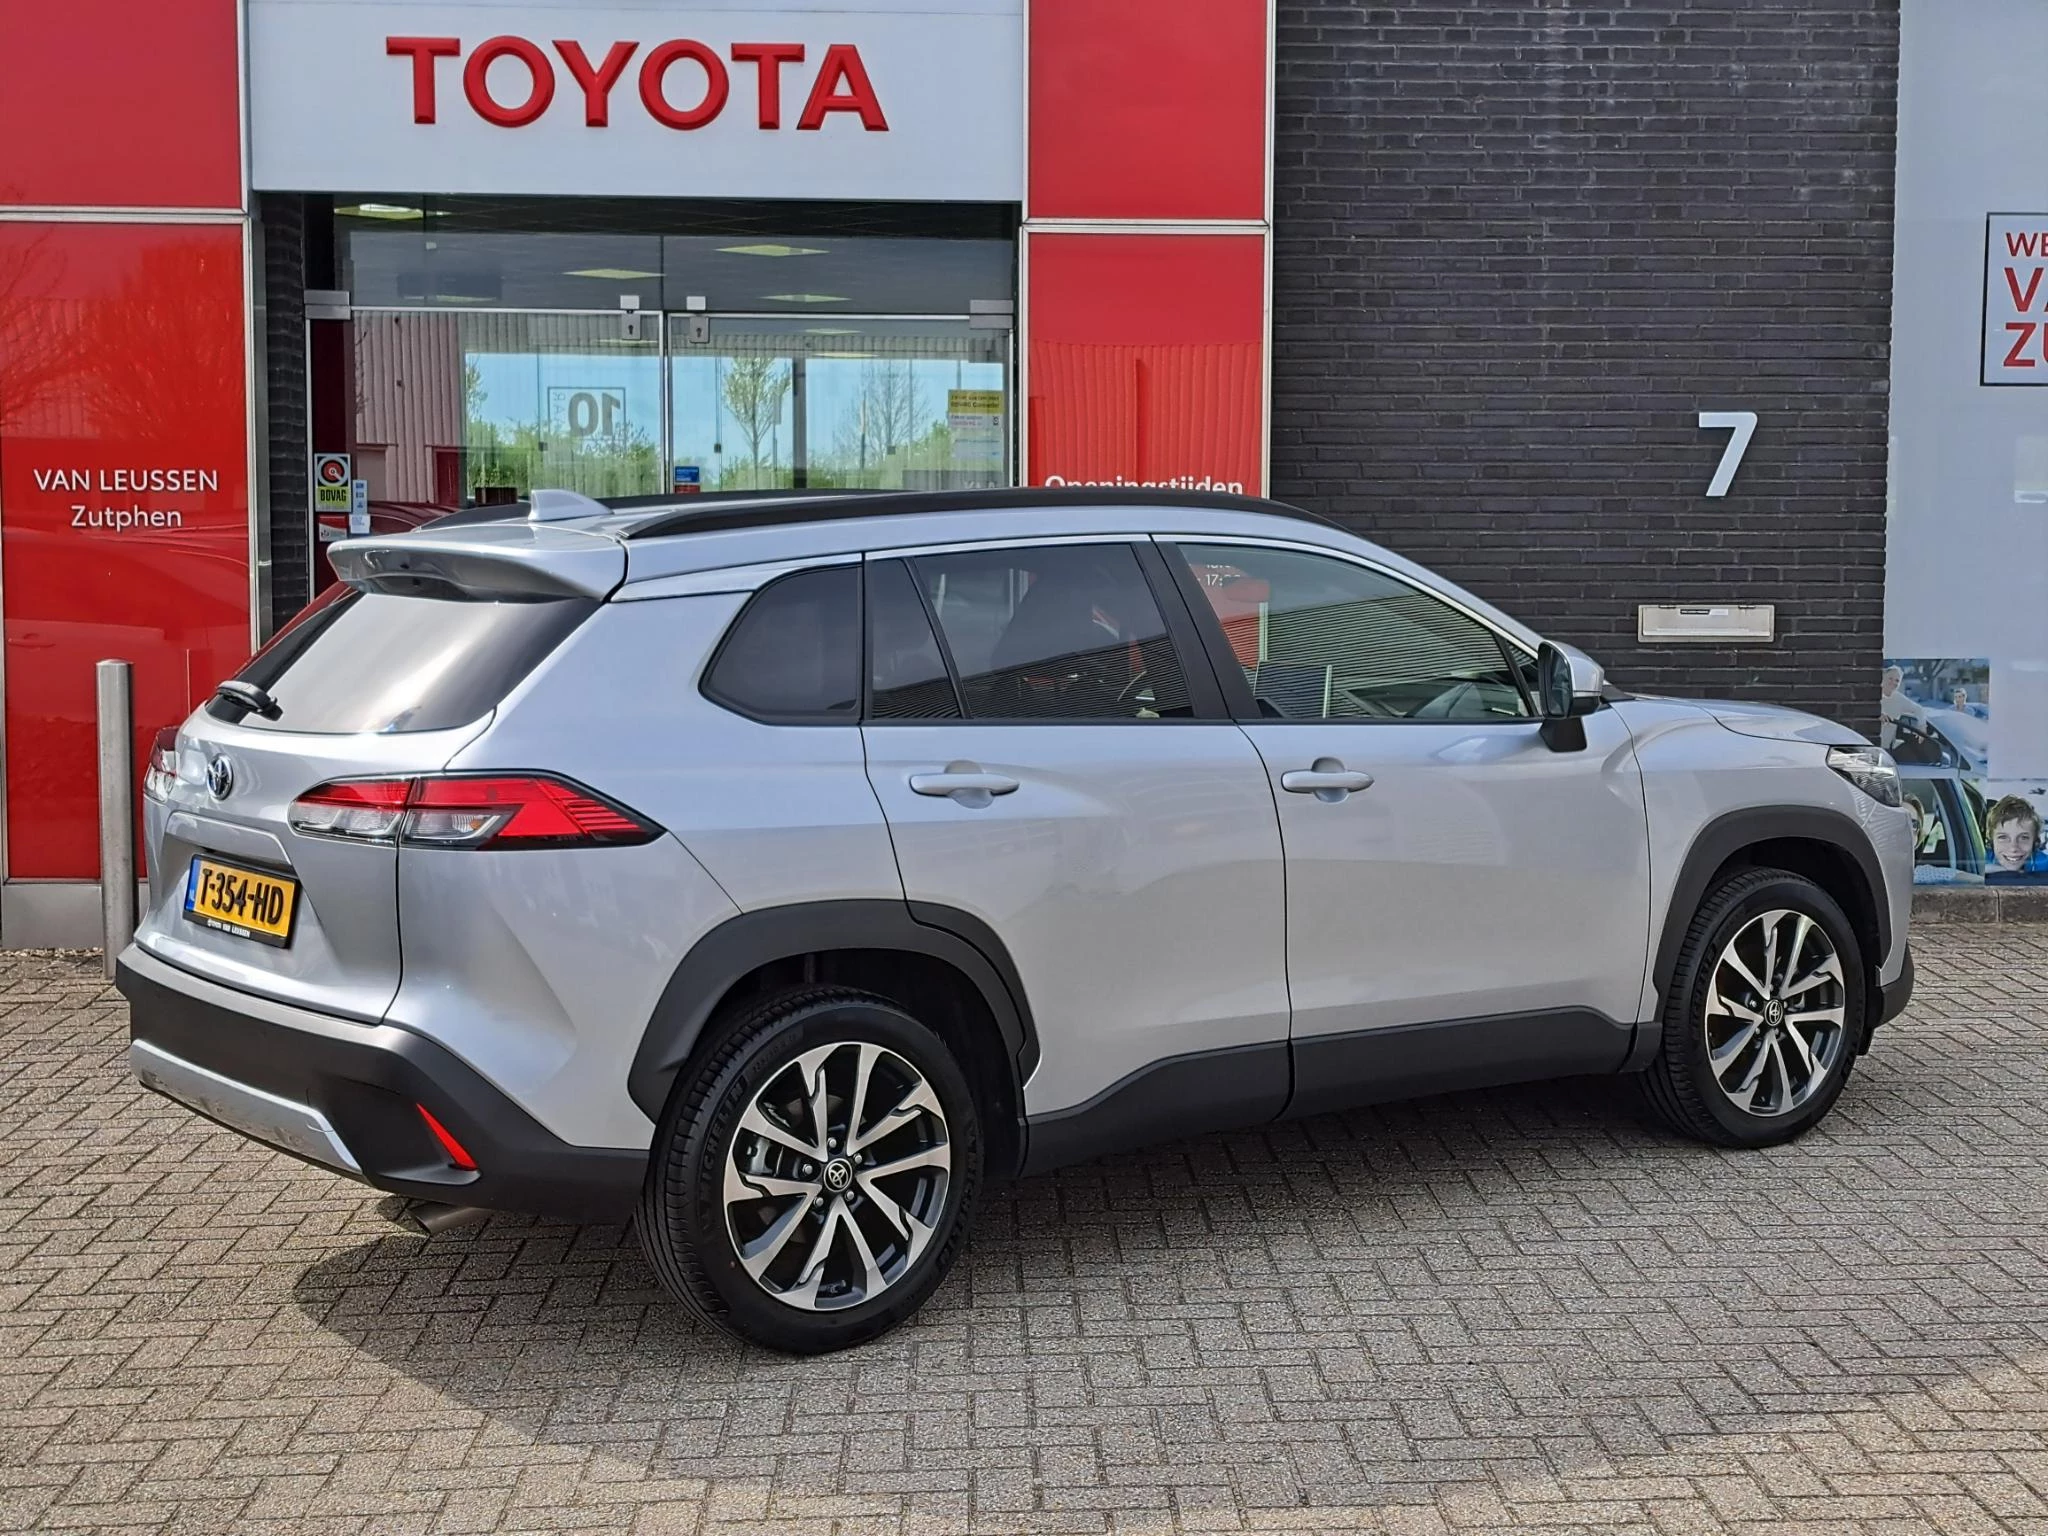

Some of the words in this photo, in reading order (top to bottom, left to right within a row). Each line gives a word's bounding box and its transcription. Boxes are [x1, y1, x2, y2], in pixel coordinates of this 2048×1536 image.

[386, 35, 889, 131] TOYOTA
[2004, 266, 2048, 313] V
[2003, 322, 2048, 367] Z
[1698, 410, 1758, 498] 7
[33, 469, 91, 492] VAN
[100, 469, 218, 492] LEUSSEN
[320, 489, 347, 502] BOVAG
[71, 504, 182, 532] Zutphen
[1205, 573, 1241, 587] 17:
[200, 868, 284, 925] T-354-HD
